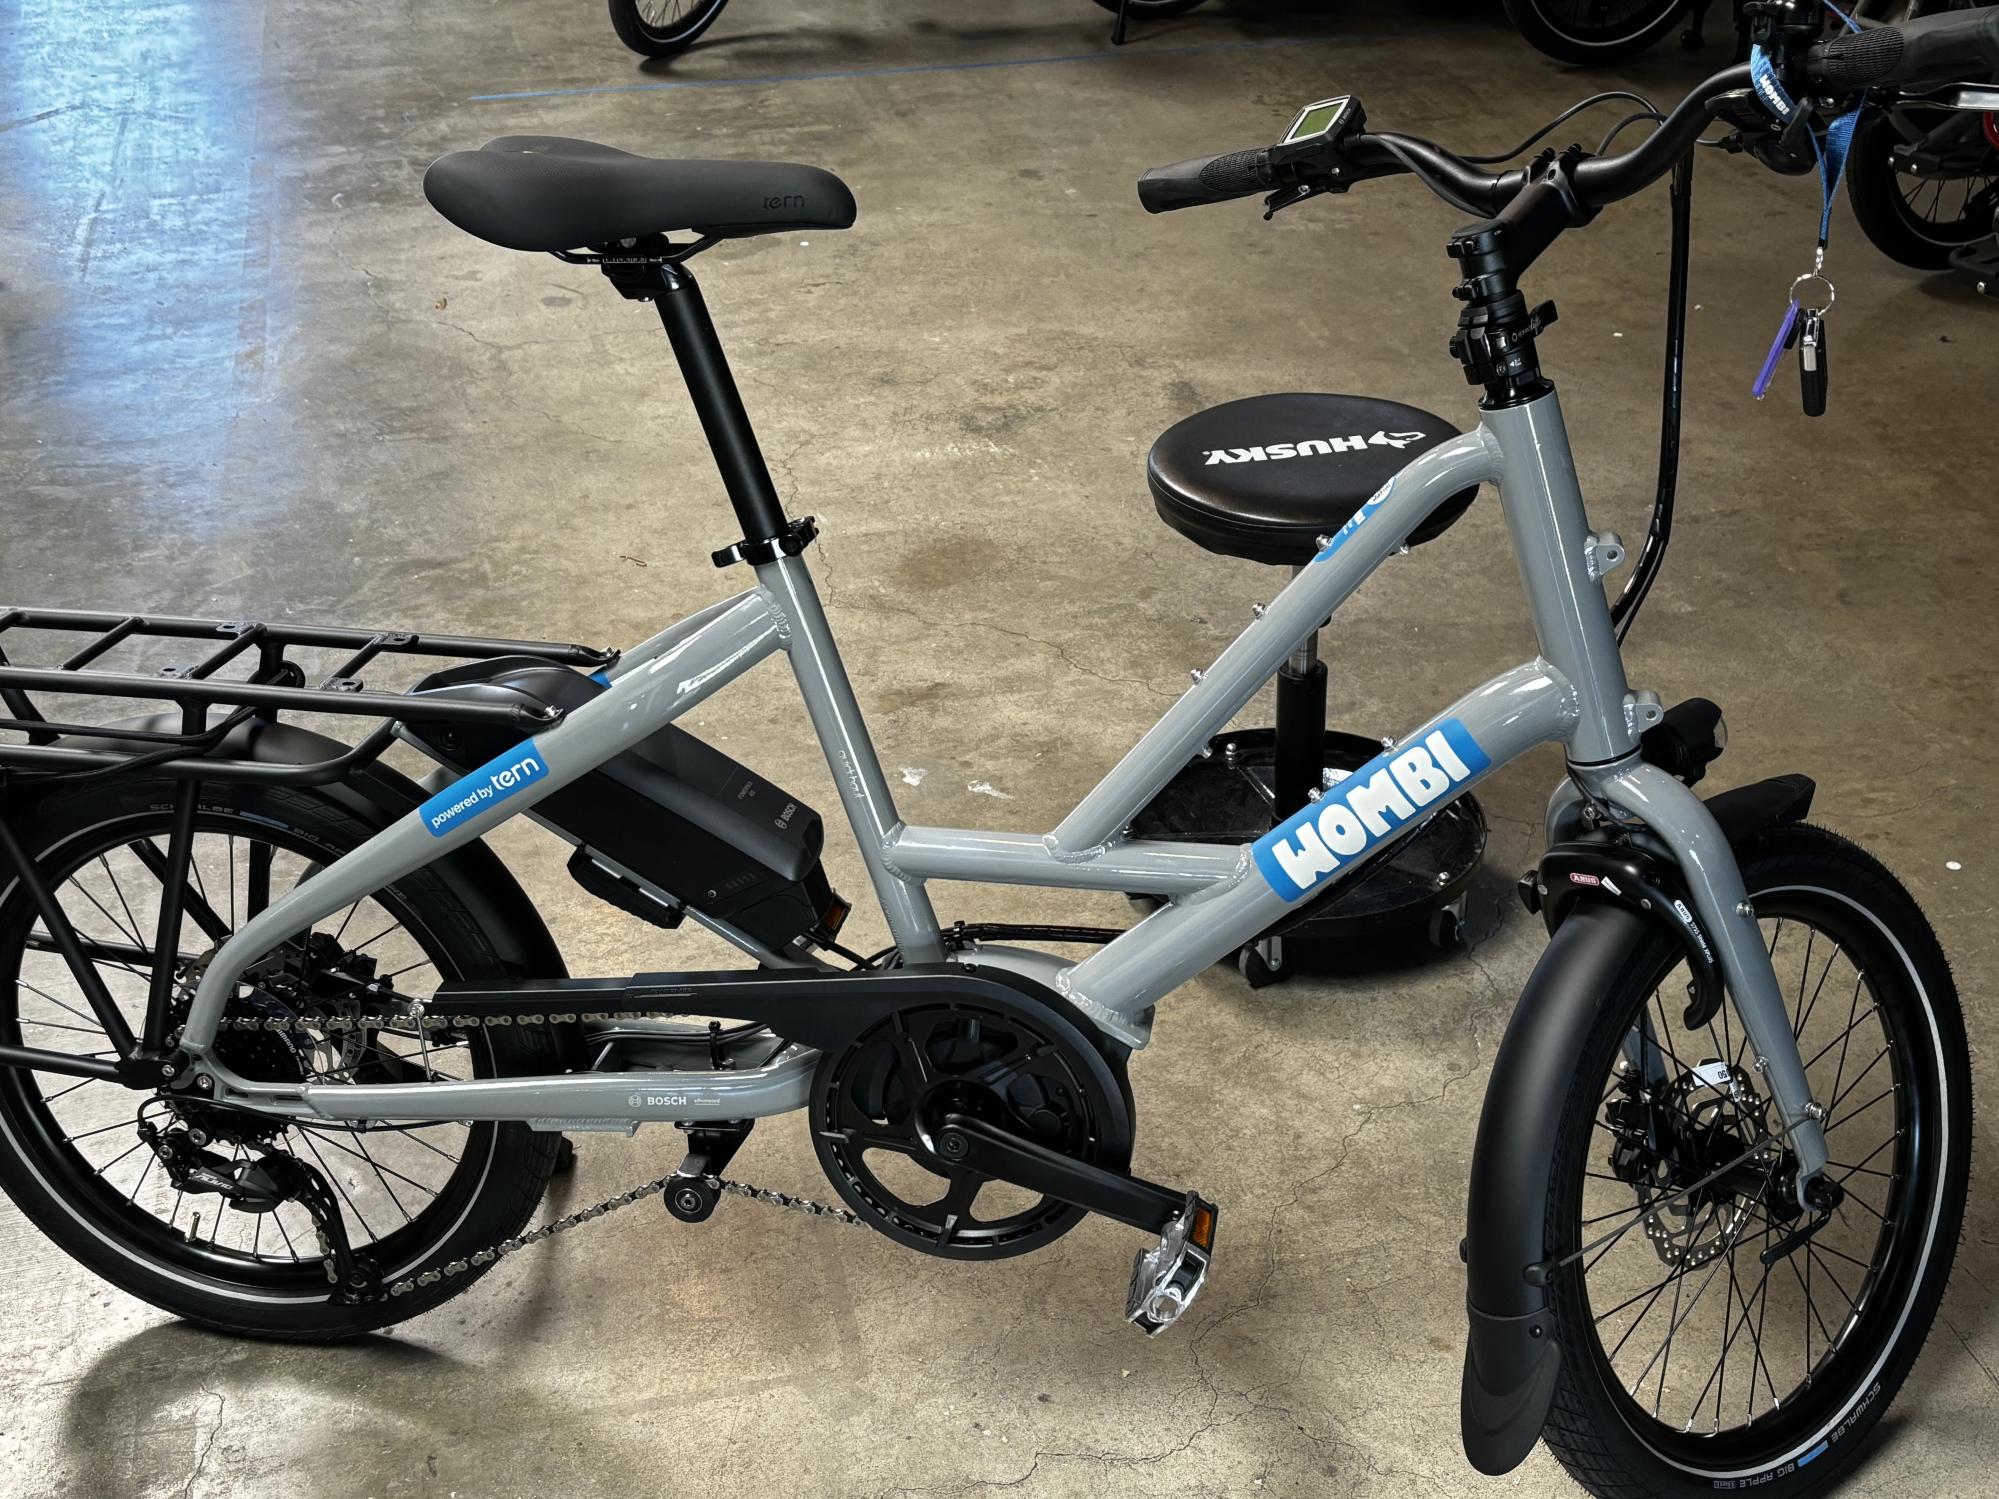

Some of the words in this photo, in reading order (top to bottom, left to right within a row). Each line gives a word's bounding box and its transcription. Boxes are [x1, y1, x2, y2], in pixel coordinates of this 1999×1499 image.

[764, 195, 806, 209] tern
[1205, 435, 1368, 466] HUSKY
[431, 792, 480, 829] powered
[477, 785, 494, 798] by
[490, 758, 540, 790] tern
[1272, 730, 1471, 889] WOMBI
[647, 1096, 687, 1106] BOSCH
[1831, 1381, 1881, 1443] SCHWALBE
[1739, 1474, 1774, 1488] APPLE
[1777, 1462, 1796, 1479] BIG
